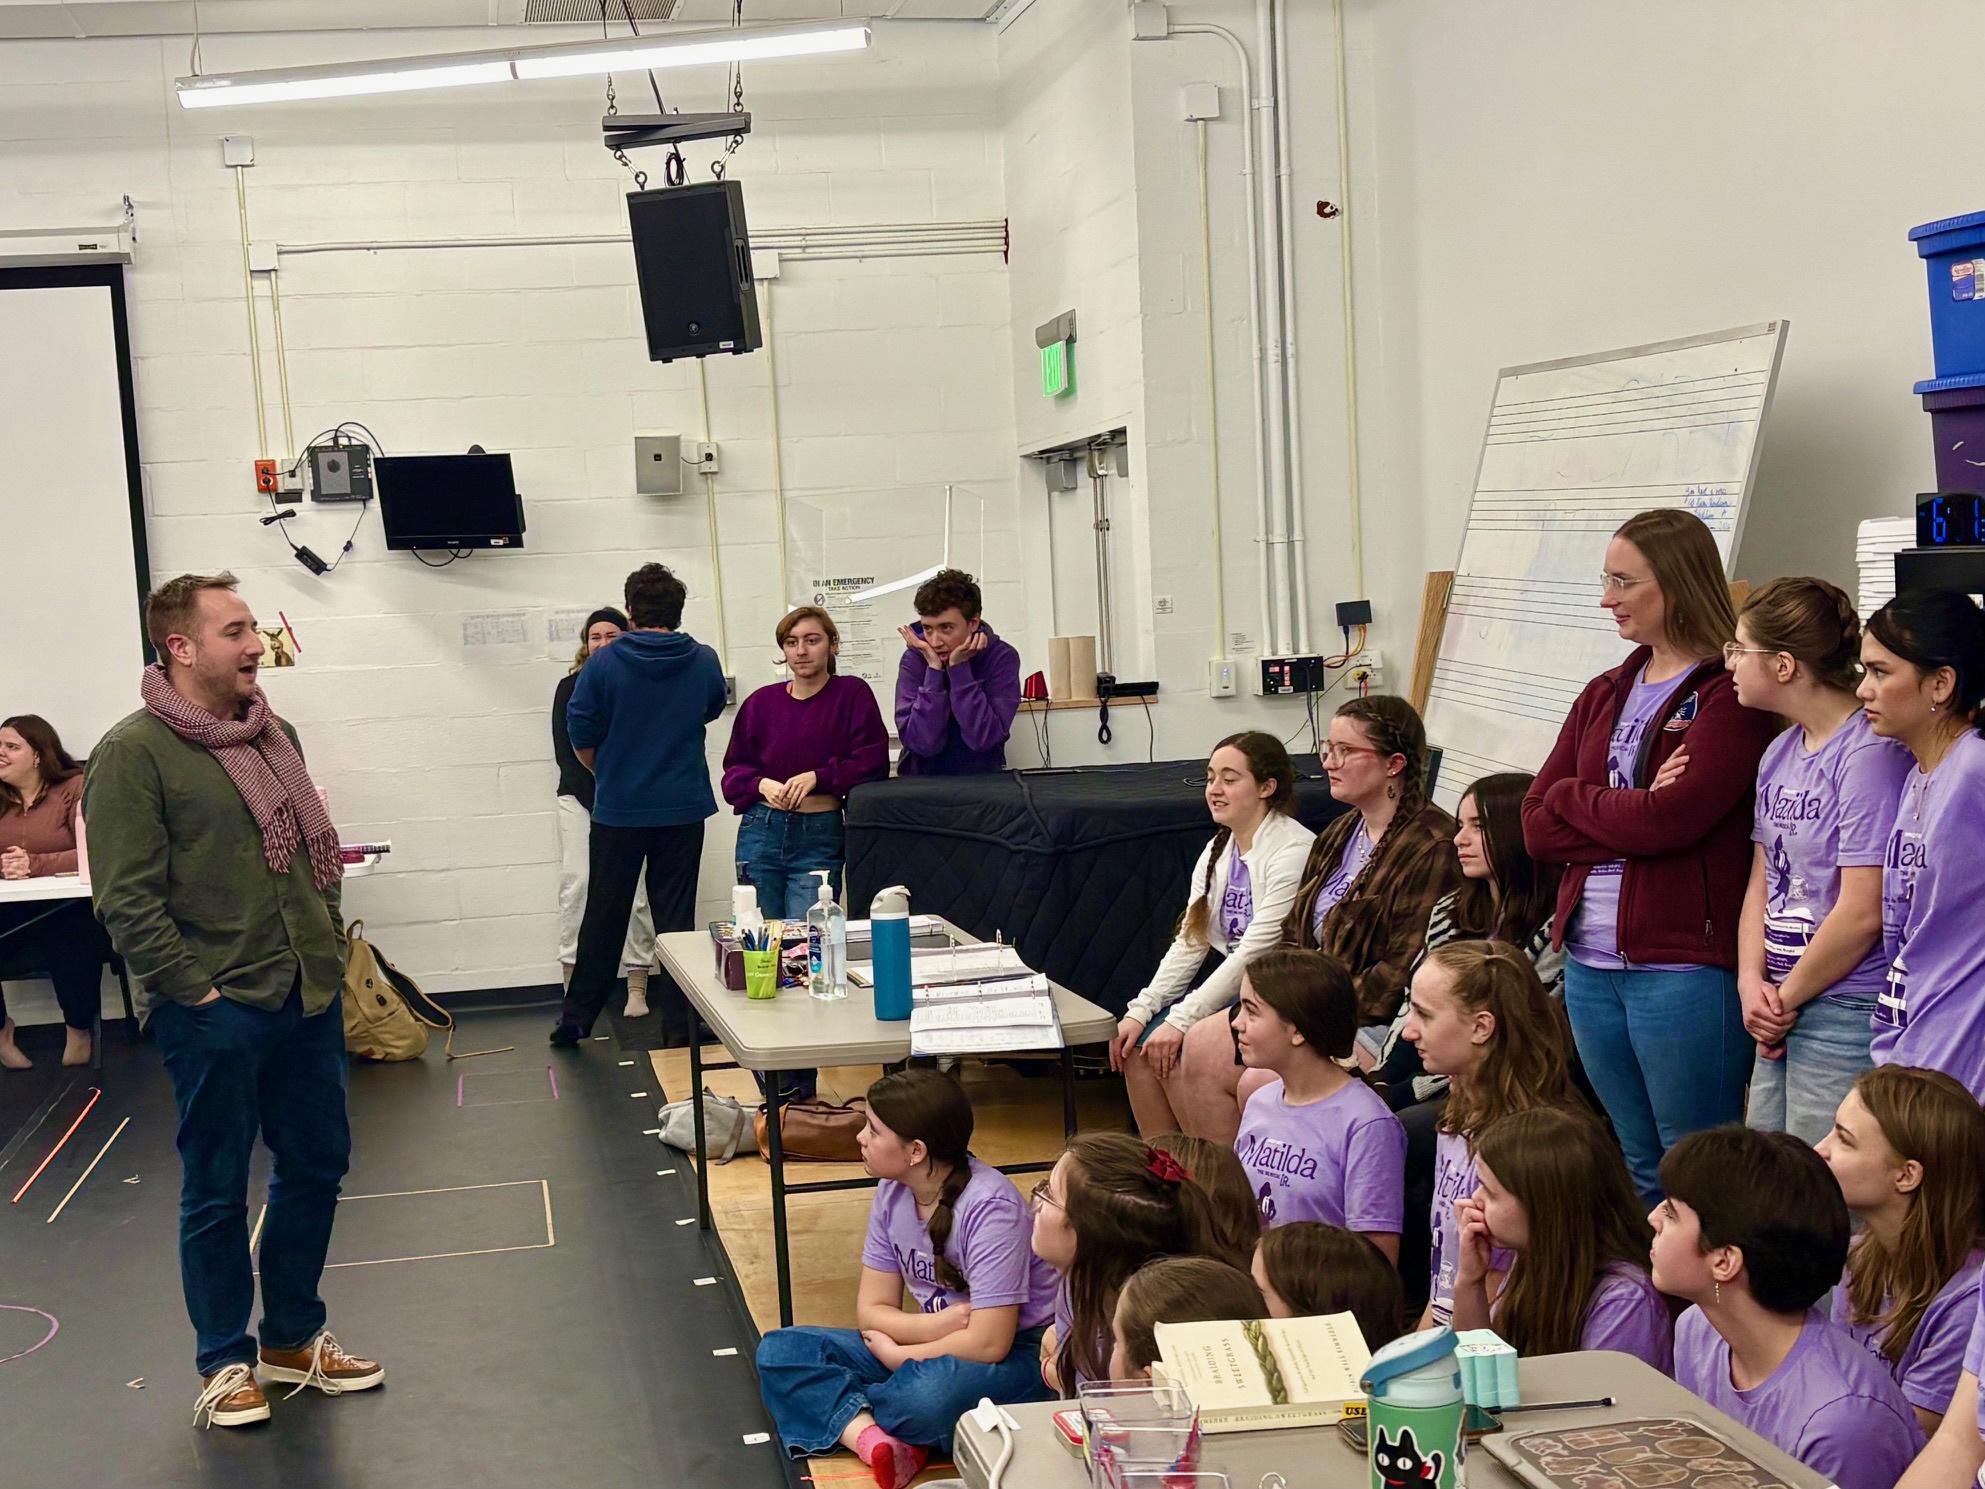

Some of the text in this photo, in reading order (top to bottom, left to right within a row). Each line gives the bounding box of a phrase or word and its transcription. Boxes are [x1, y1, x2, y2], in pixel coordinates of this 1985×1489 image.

[833, 577, 875, 587] EMERGENCY
[1240, 1133, 1318, 1180] Matilda
[1202, 1345, 1224, 1385] BRAIDING
[1222, 1337, 1247, 1389] SWEETGRASS
[1345, 1406, 1367, 1416] USE
